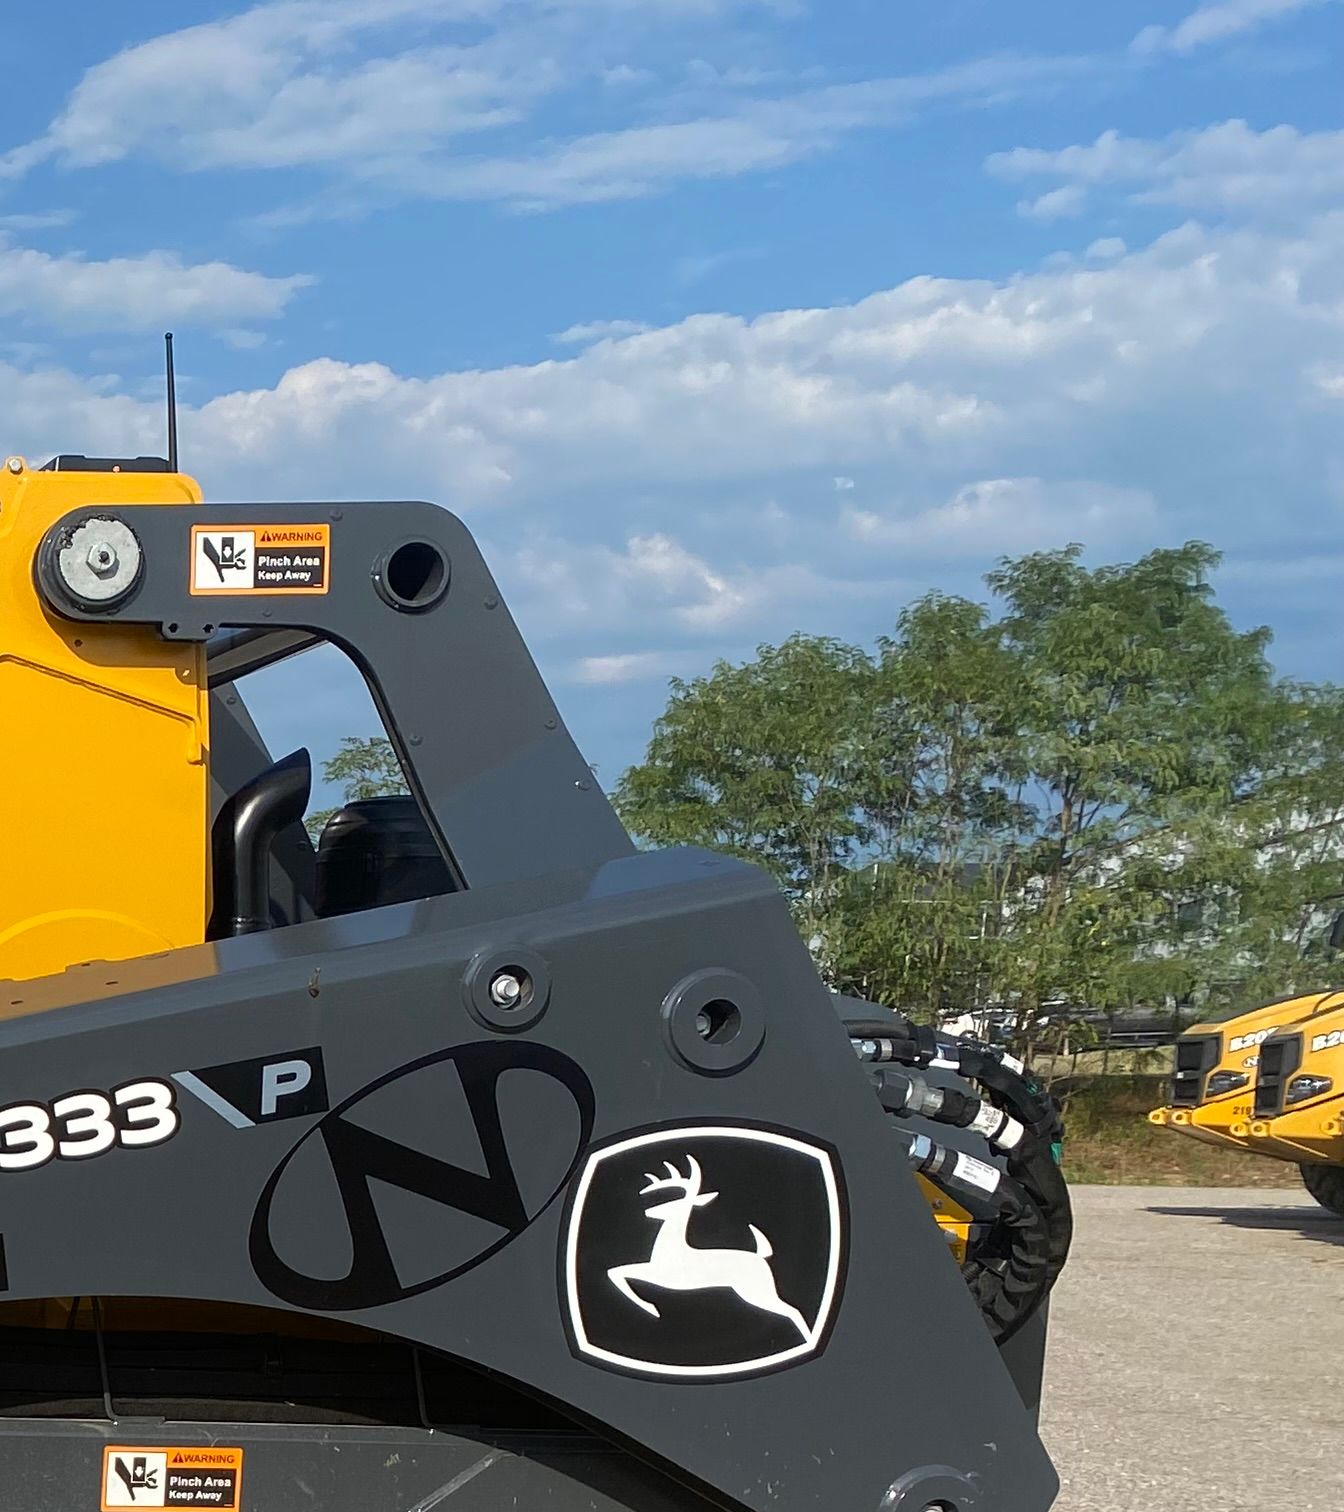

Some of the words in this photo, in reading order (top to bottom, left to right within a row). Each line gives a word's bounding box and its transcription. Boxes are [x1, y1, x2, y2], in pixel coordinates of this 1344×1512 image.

[271, 532, 322, 542] WARNING
[258, 556, 291, 567] Pinch
[293, 555, 320, 567] Area
[258, 570, 283, 581] Keep
[284, 570, 312, 582] Away
[1312, 1031, 1344, 1051] B2
[184, 1454, 235, 1464] WARNING
[169, 1476, 202, 1487] Pinch
[204, 1476, 232, 1488] Area
[168, 1490, 193, 1501] Keep
[195, 1490, 223, 1502] Away
